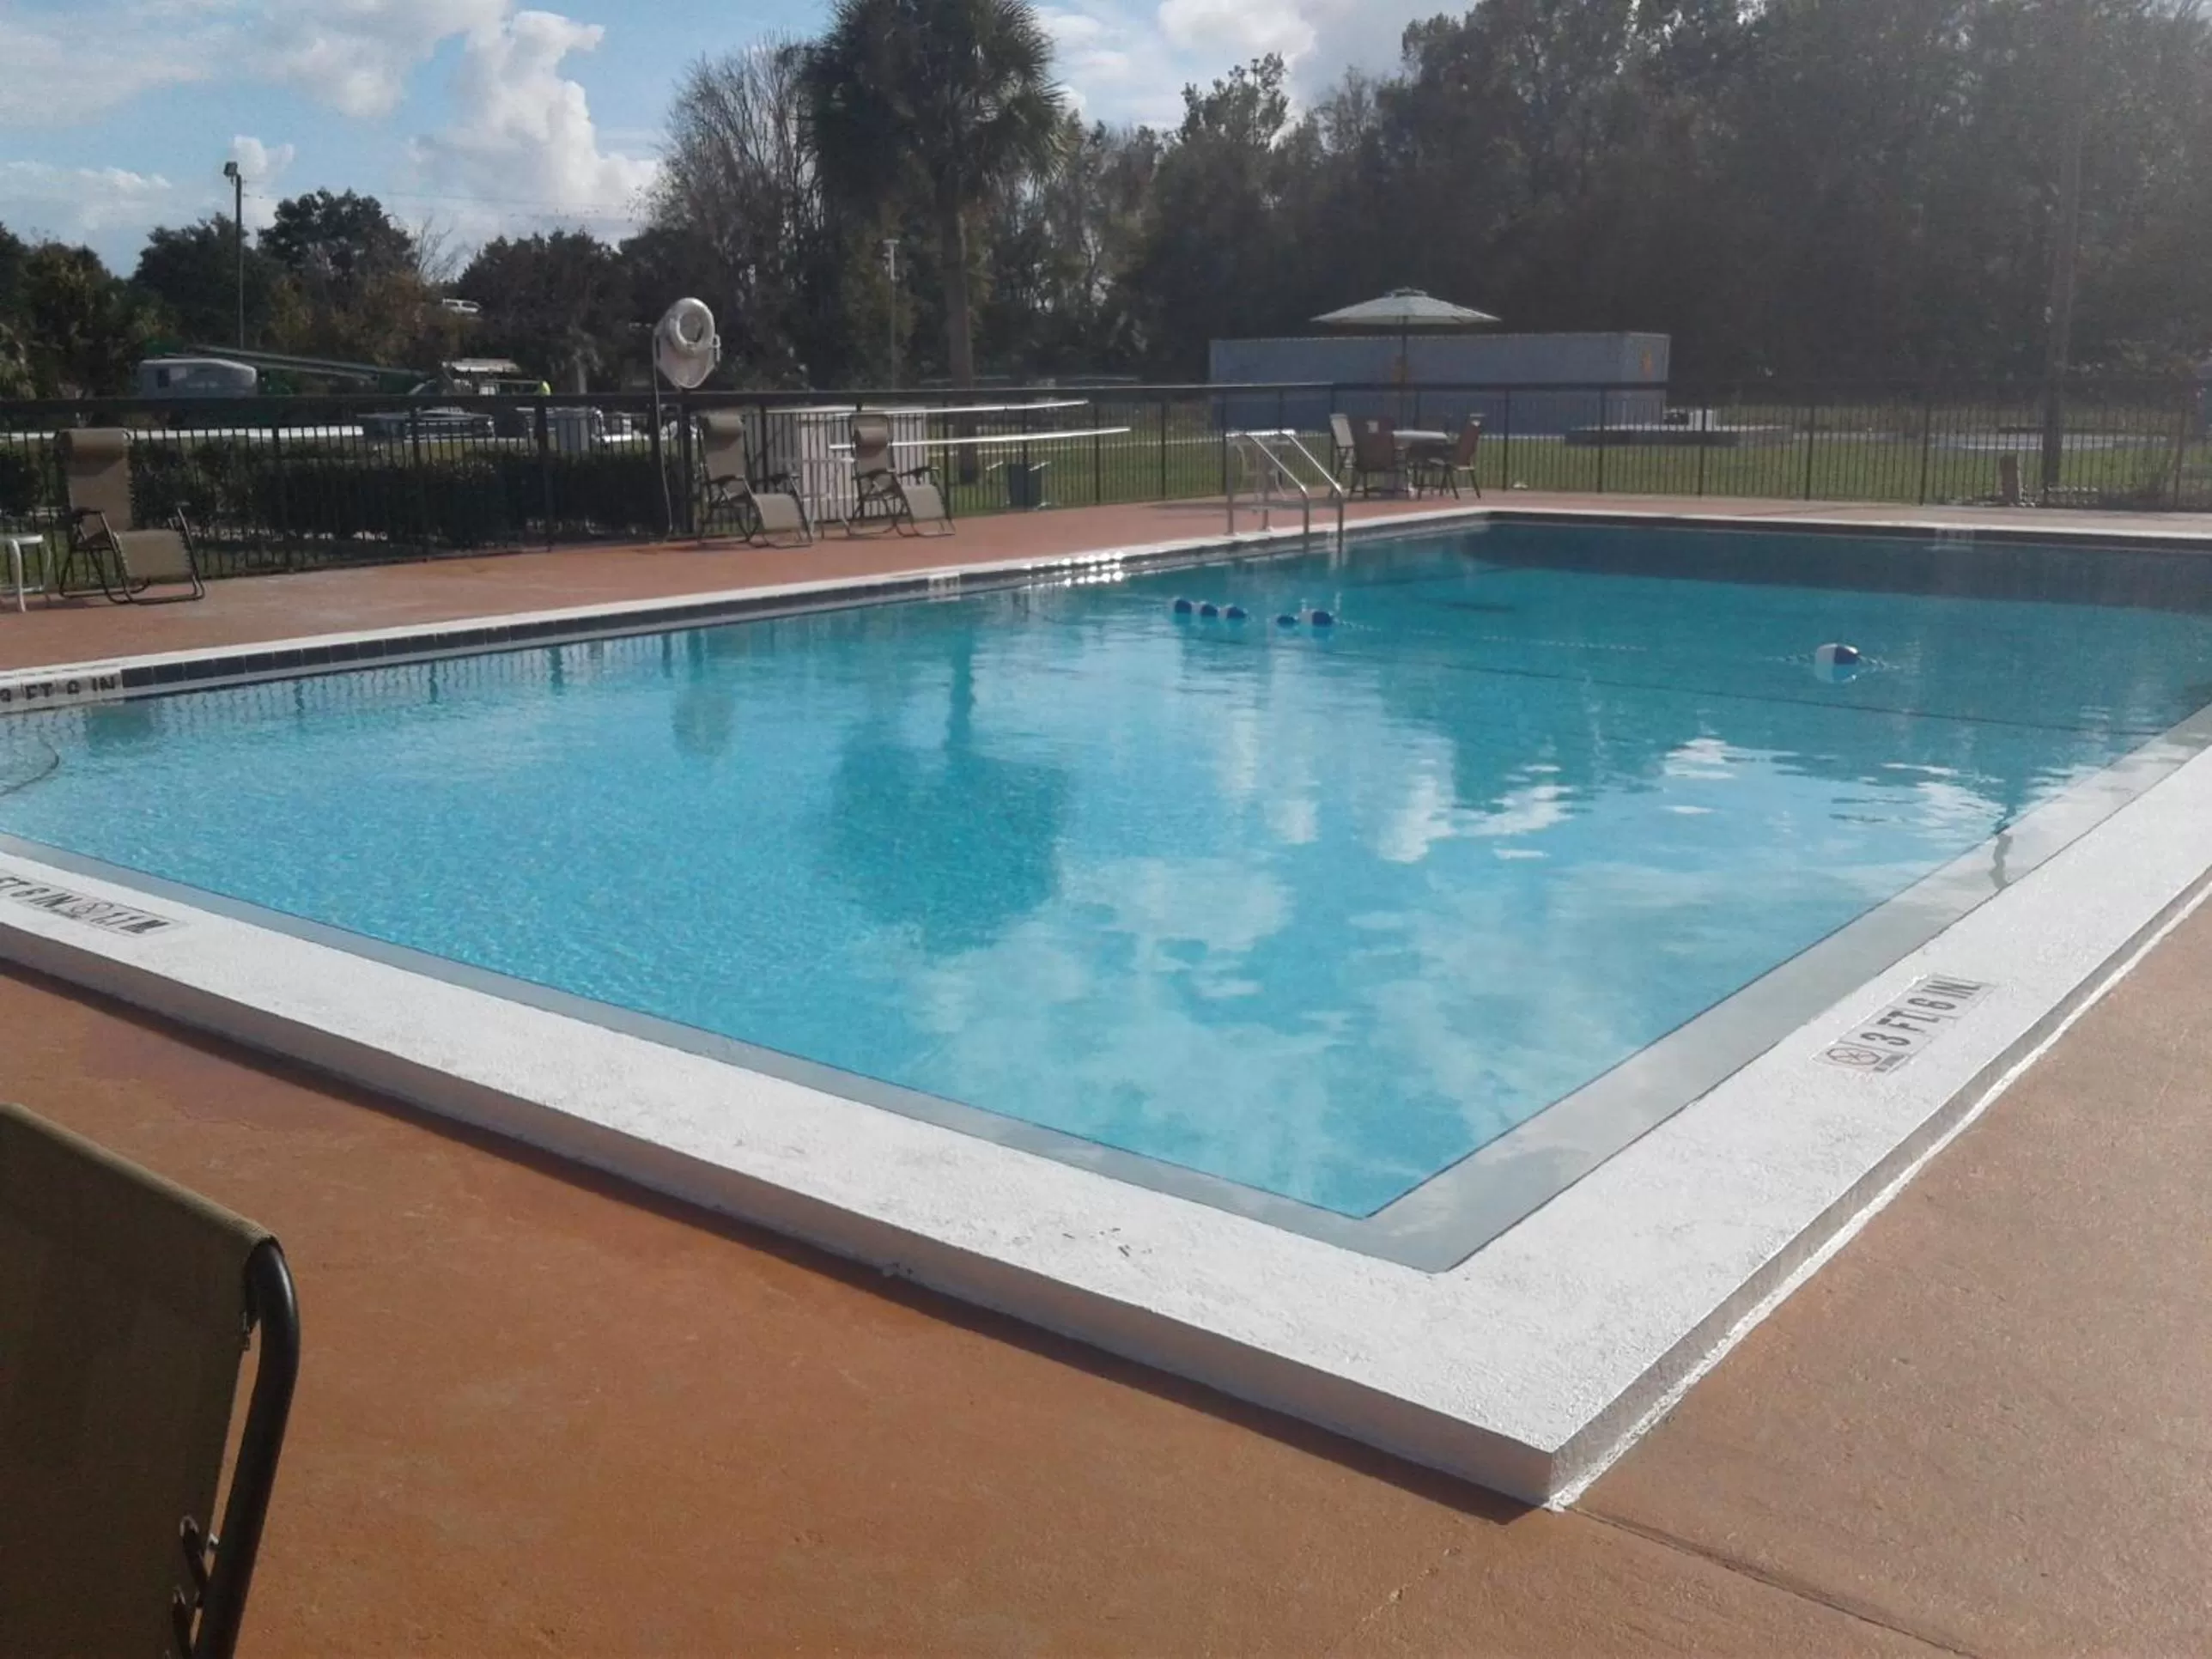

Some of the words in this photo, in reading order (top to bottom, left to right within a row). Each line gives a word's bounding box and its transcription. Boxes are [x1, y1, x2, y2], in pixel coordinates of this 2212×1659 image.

[25, 683, 52, 700] FT
[92, 675, 115, 691] IN
[1920, 980, 1981, 999] IN
[1907, 997, 1957, 1011] 6
[1876, 1011, 1940, 1032] FT
[1860, 1032, 1911, 1046] 3
